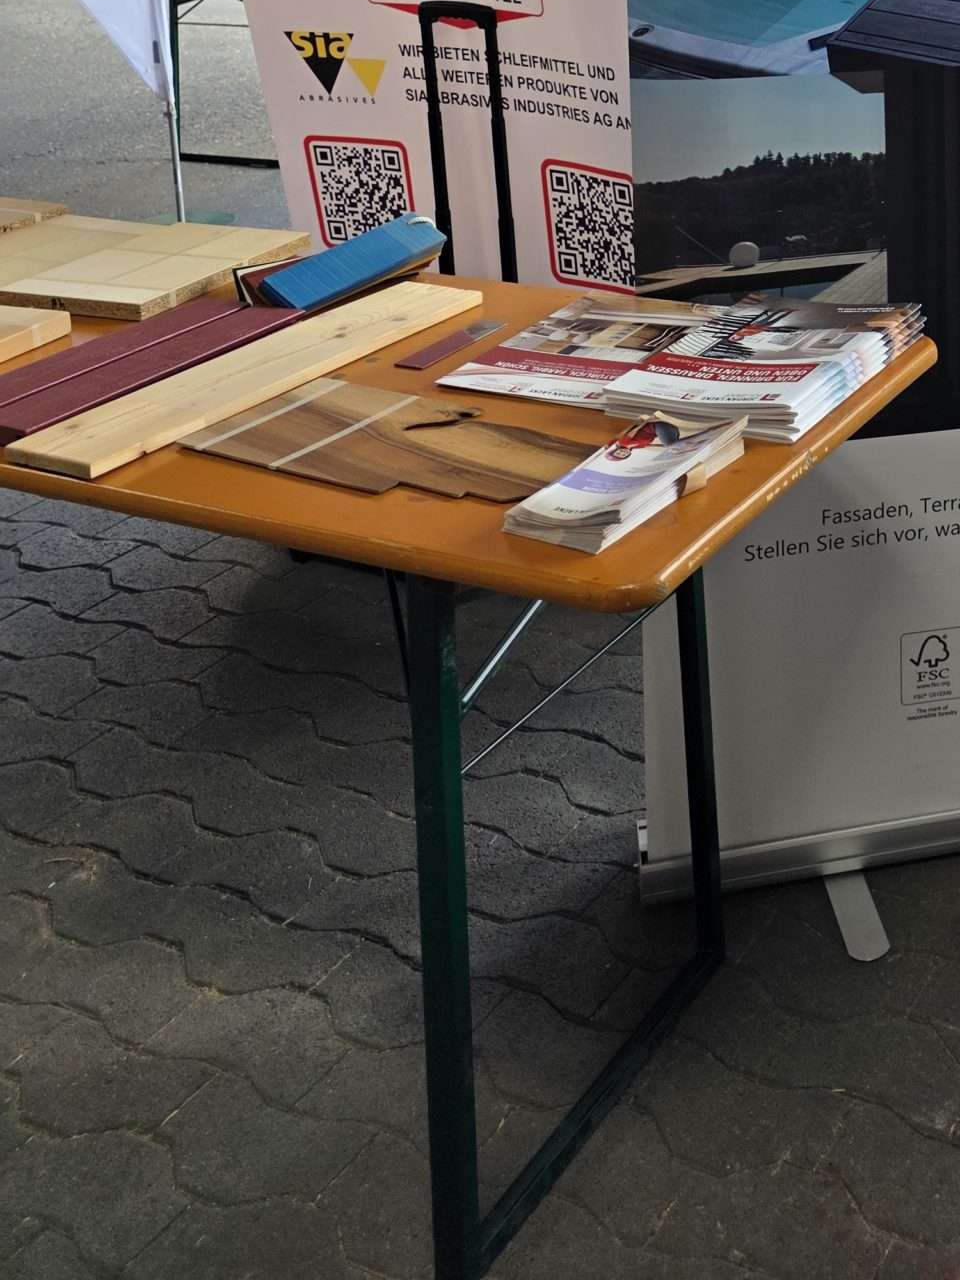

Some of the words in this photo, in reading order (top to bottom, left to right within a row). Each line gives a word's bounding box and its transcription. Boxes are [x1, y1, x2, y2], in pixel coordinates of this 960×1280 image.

[587, 64, 615, 81] UND
[403, 65, 438, 81] ALL
[518, 76, 587, 100] PRODUKTE
[590, 88, 618, 105] VON
[299, 94, 376, 105] ABRASIVES
[438, 91, 510, 110] BRASIVS
[514, 98, 589, 123] INDUSTRIES
[593, 112, 612, 127] AG
[821, 502, 913, 526] Fassaden,
[744, 539, 809, 562] Stellen
[816, 534, 845, 552] Sie
[851, 528, 887, 548] sich
[893, 525, 929, 543] vor,
[917, 668, 949, 683] FSC
